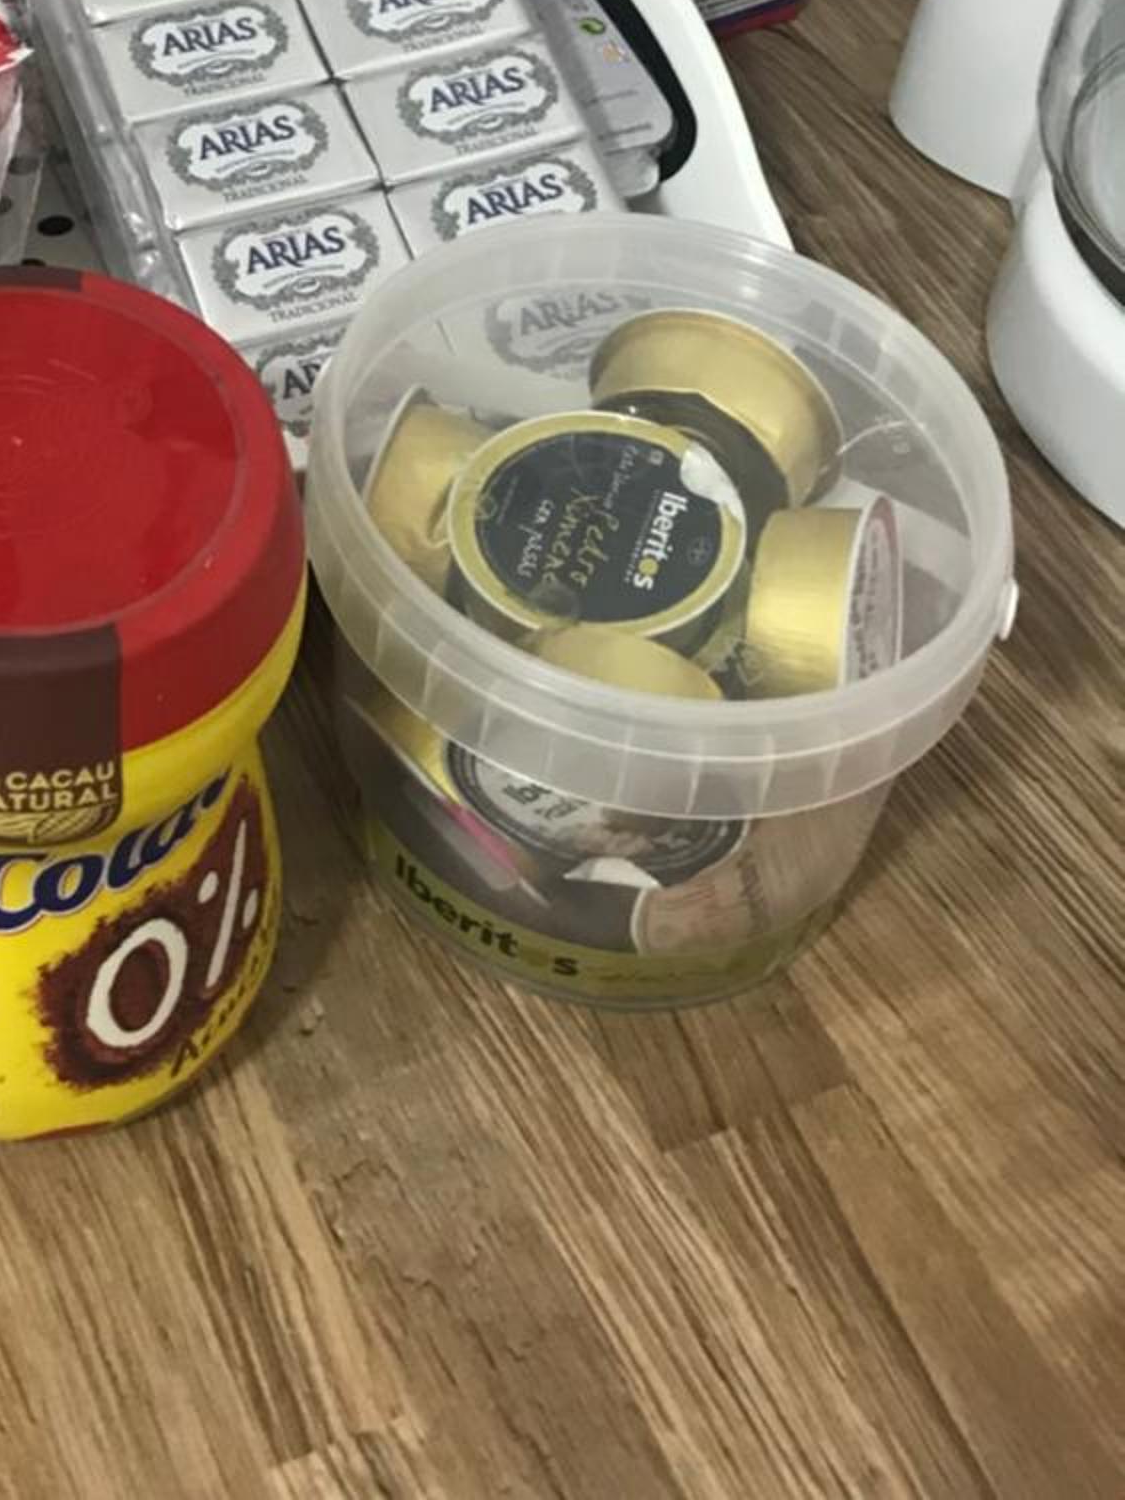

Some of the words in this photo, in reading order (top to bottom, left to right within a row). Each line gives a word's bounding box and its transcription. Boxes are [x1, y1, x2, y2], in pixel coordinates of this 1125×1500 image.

[161, 16, 259, 57] ARIAS
[428, 66, 525, 114] ARIAS
[198, 114, 297, 162] ARIAS
[466, 173, 565, 226] ARIAS
[245, 225, 347, 276] ARIAS
[268, 292, 360, 323] TRADICIONAL
[86, 819, 260, 1048] 0%
